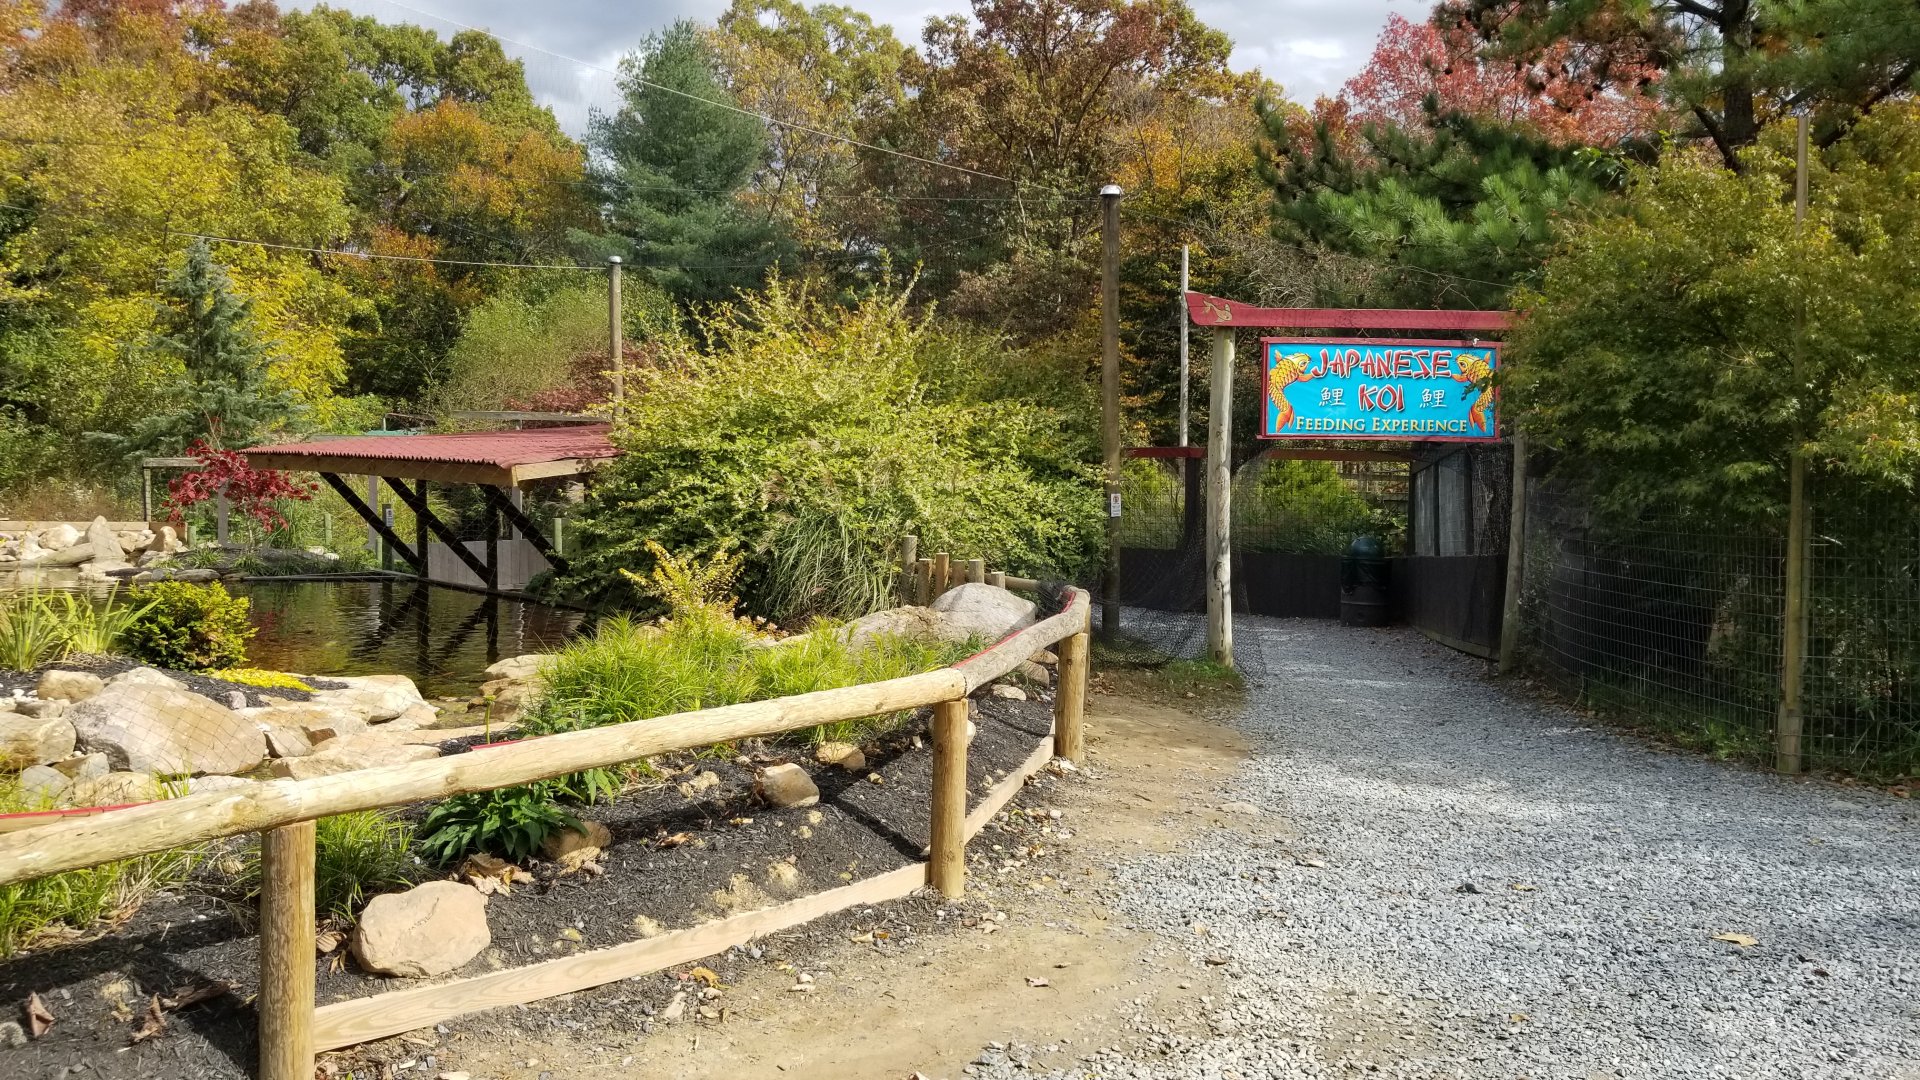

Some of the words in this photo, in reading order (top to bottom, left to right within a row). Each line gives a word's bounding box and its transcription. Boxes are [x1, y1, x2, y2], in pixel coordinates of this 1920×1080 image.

[1311, 349, 1452, 379] JAPANESE
[1319, 387, 1346, 407] 鯉
[1358, 384, 1405, 412] KOI
[1419, 388, 1447, 408] 鯉
